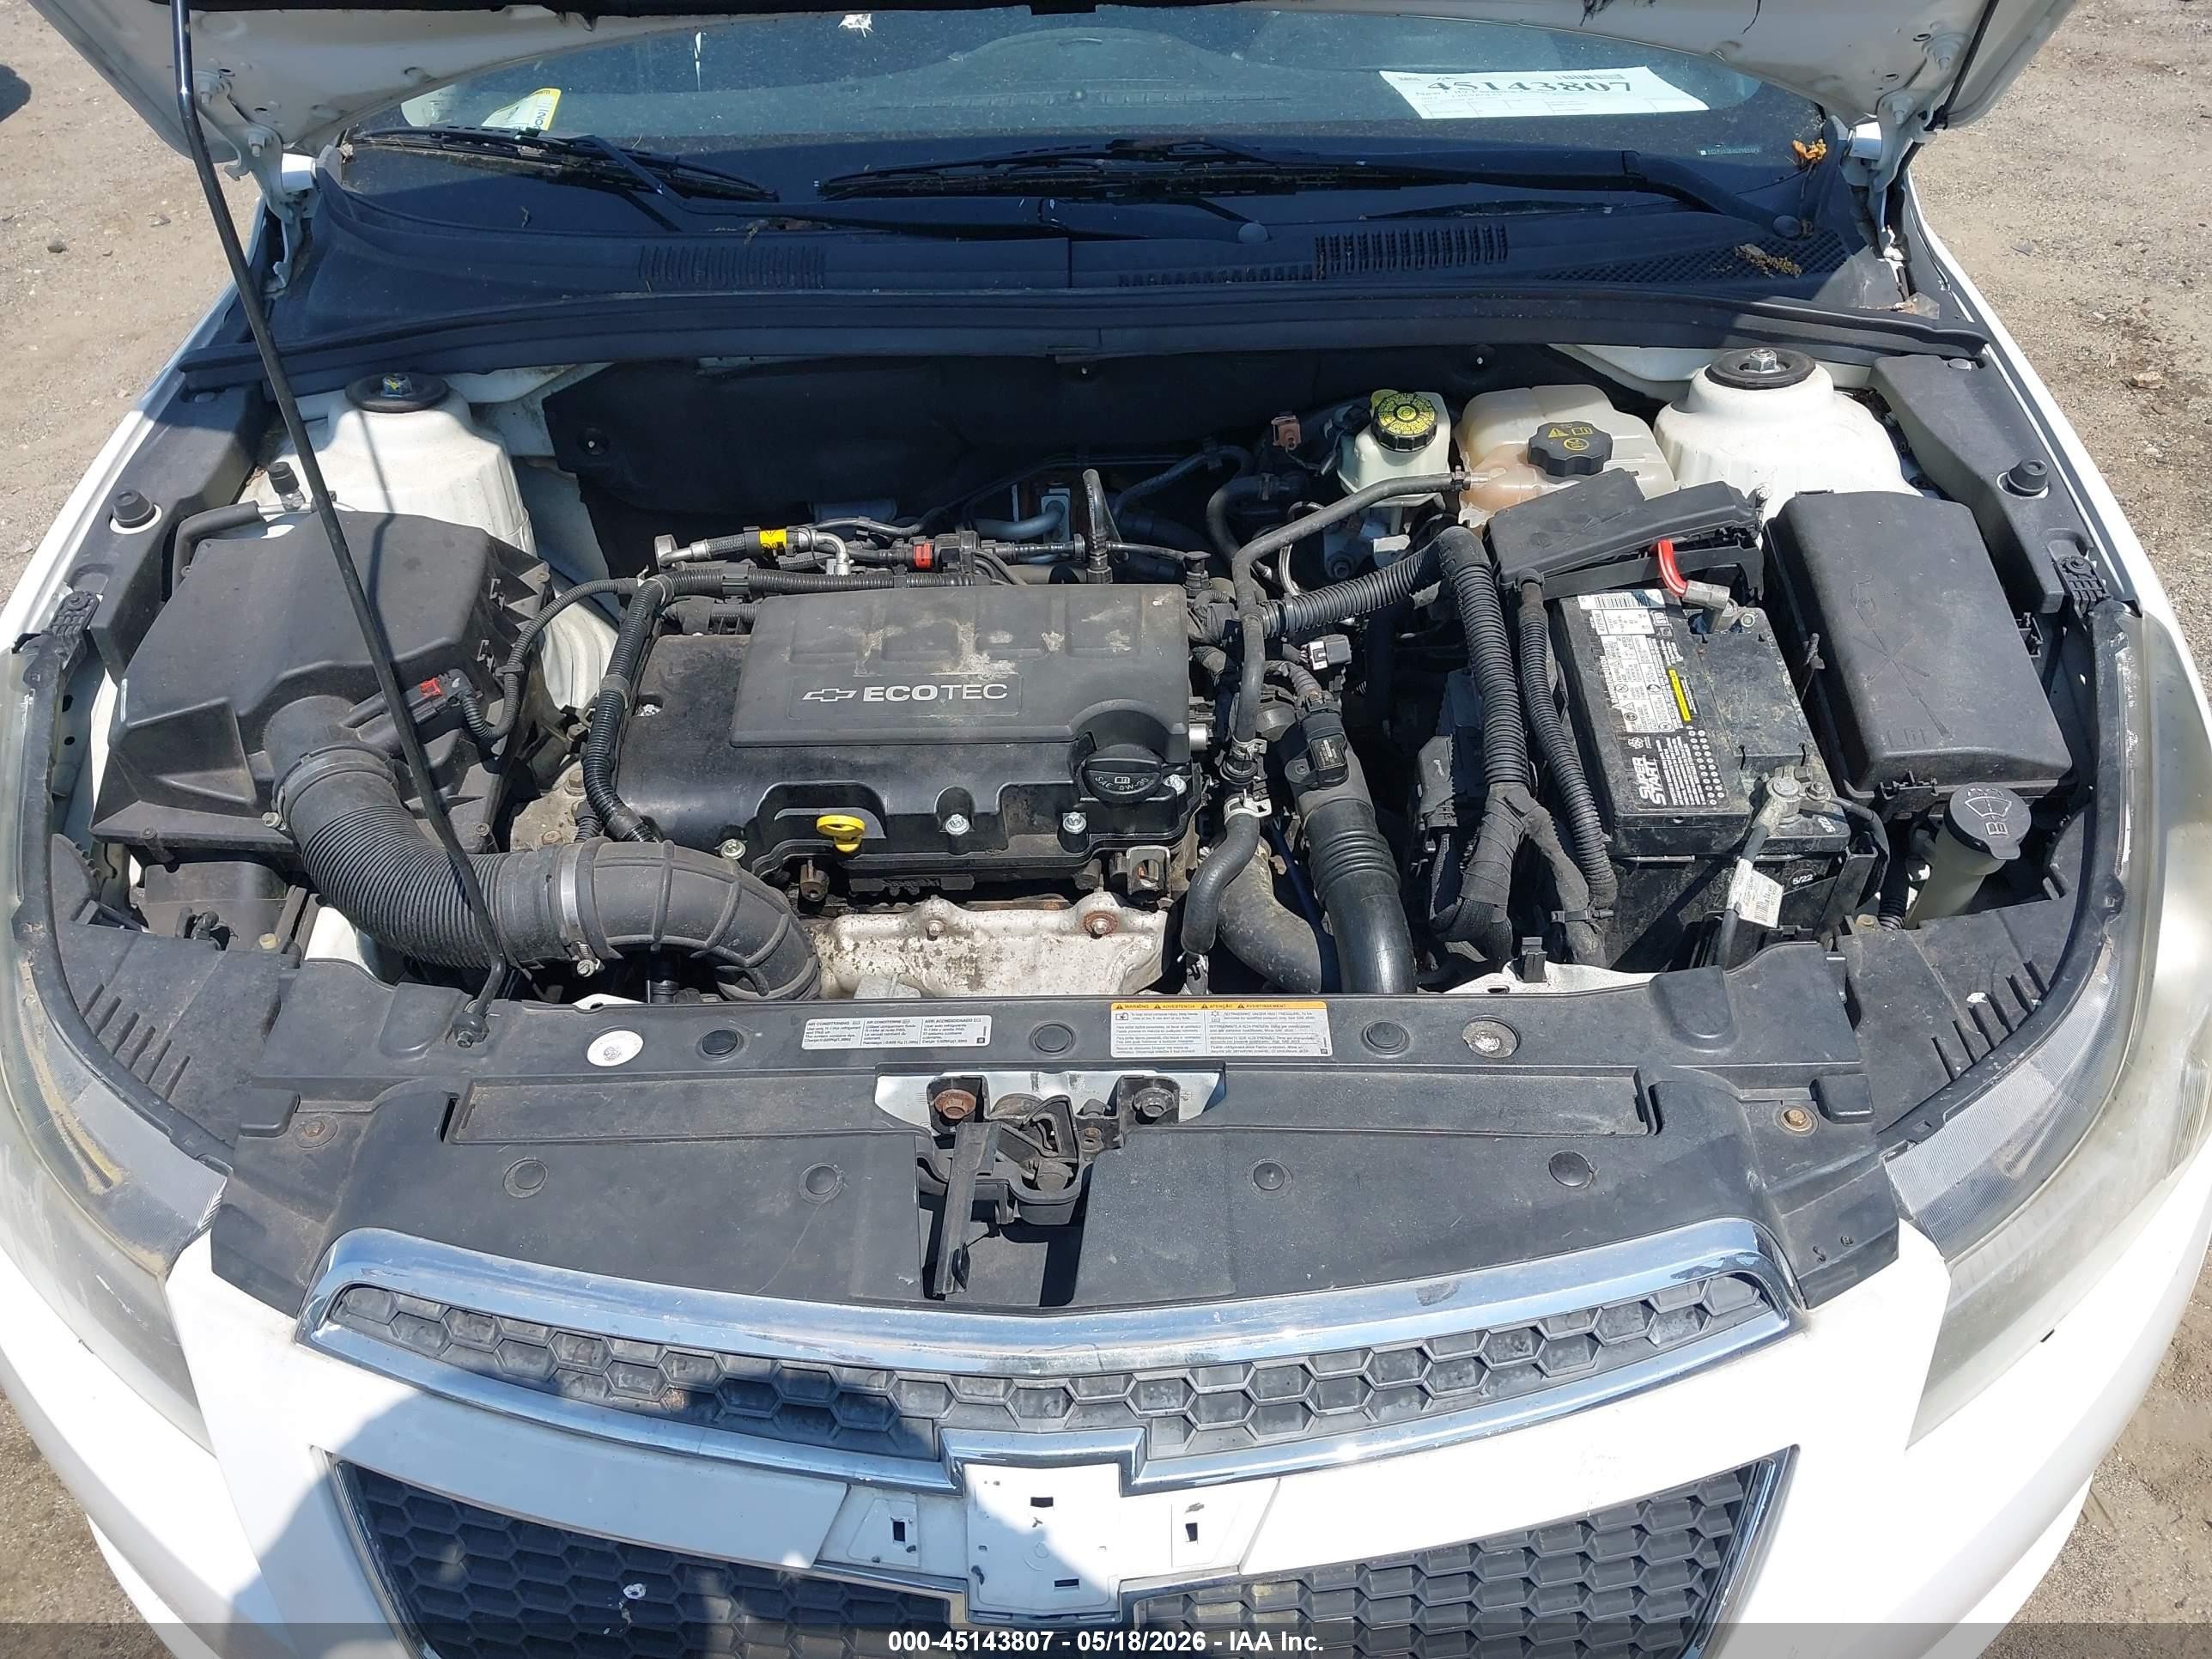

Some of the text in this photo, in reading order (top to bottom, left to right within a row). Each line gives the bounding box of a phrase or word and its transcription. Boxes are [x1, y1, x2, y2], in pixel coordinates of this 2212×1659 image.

[1425, 81, 1634, 92] 45143807
[862, 684, 1008, 702] ECOTEC
[1094, 775, 1113, 788] SAE
[1632, 757, 1650, 799] SUPER
[1817, 816, 1836, 833] 5/22
[1792, 873, 1814, 885] 5/22
